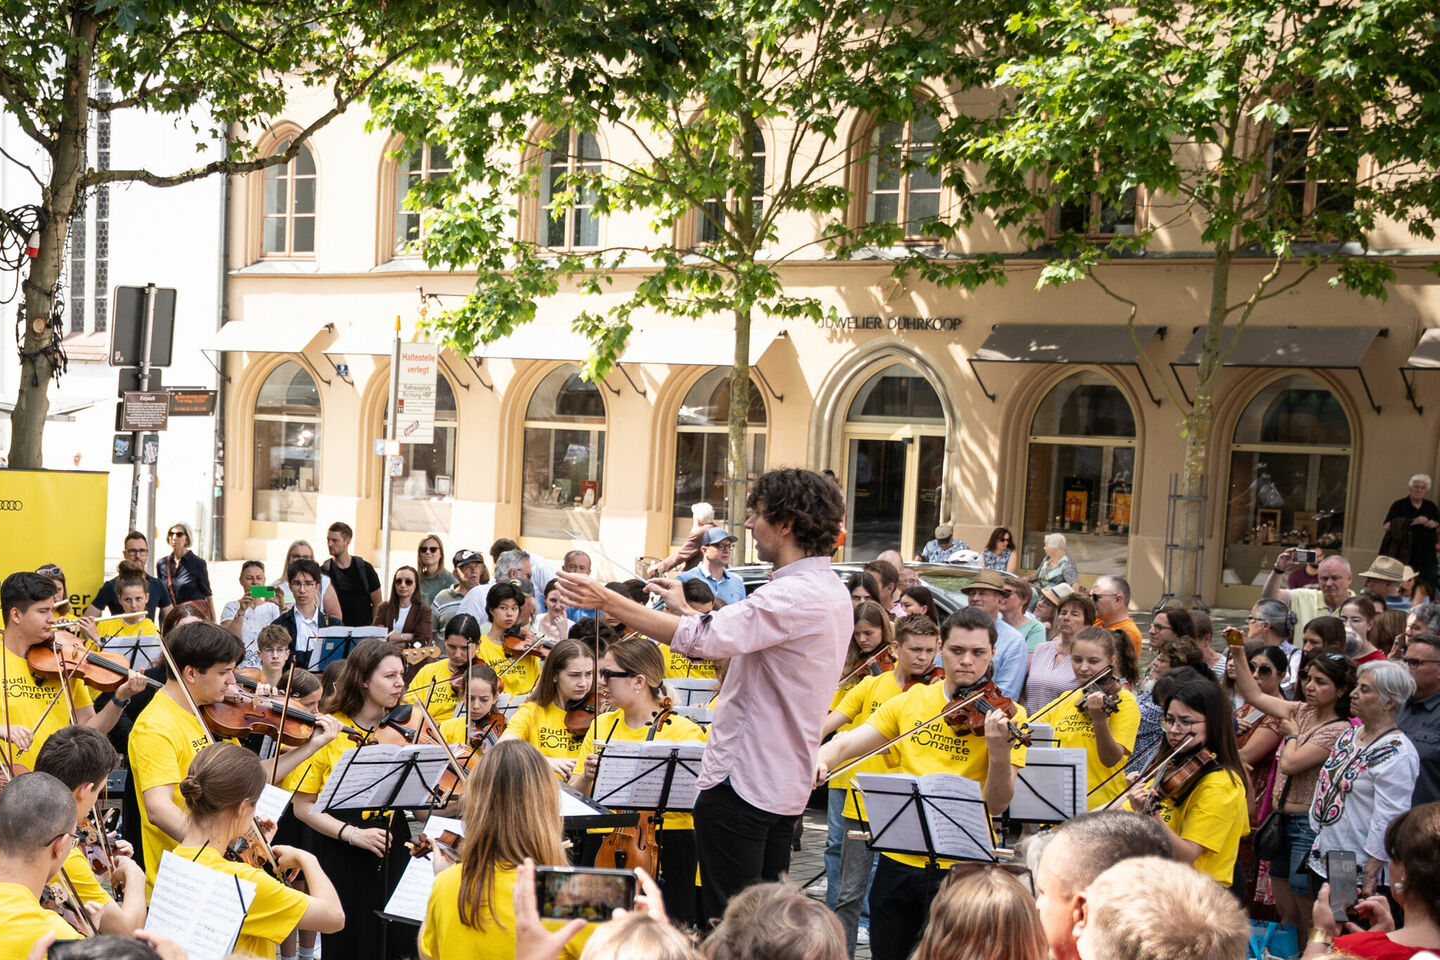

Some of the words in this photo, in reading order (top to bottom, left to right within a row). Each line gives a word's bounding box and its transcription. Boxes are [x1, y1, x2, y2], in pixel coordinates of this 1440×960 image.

[818, 316, 882, 330] JUWELIER
[887, 315, 963, 331] DÜHRKOOP
[402, 352, 436, 363] Haltestelle
[407, 367, 429, 376] verlegt
[540, 727, 567, 736] audi
[191, 734, 209, 748] aud
[951, 754, 968, 762] 2023
